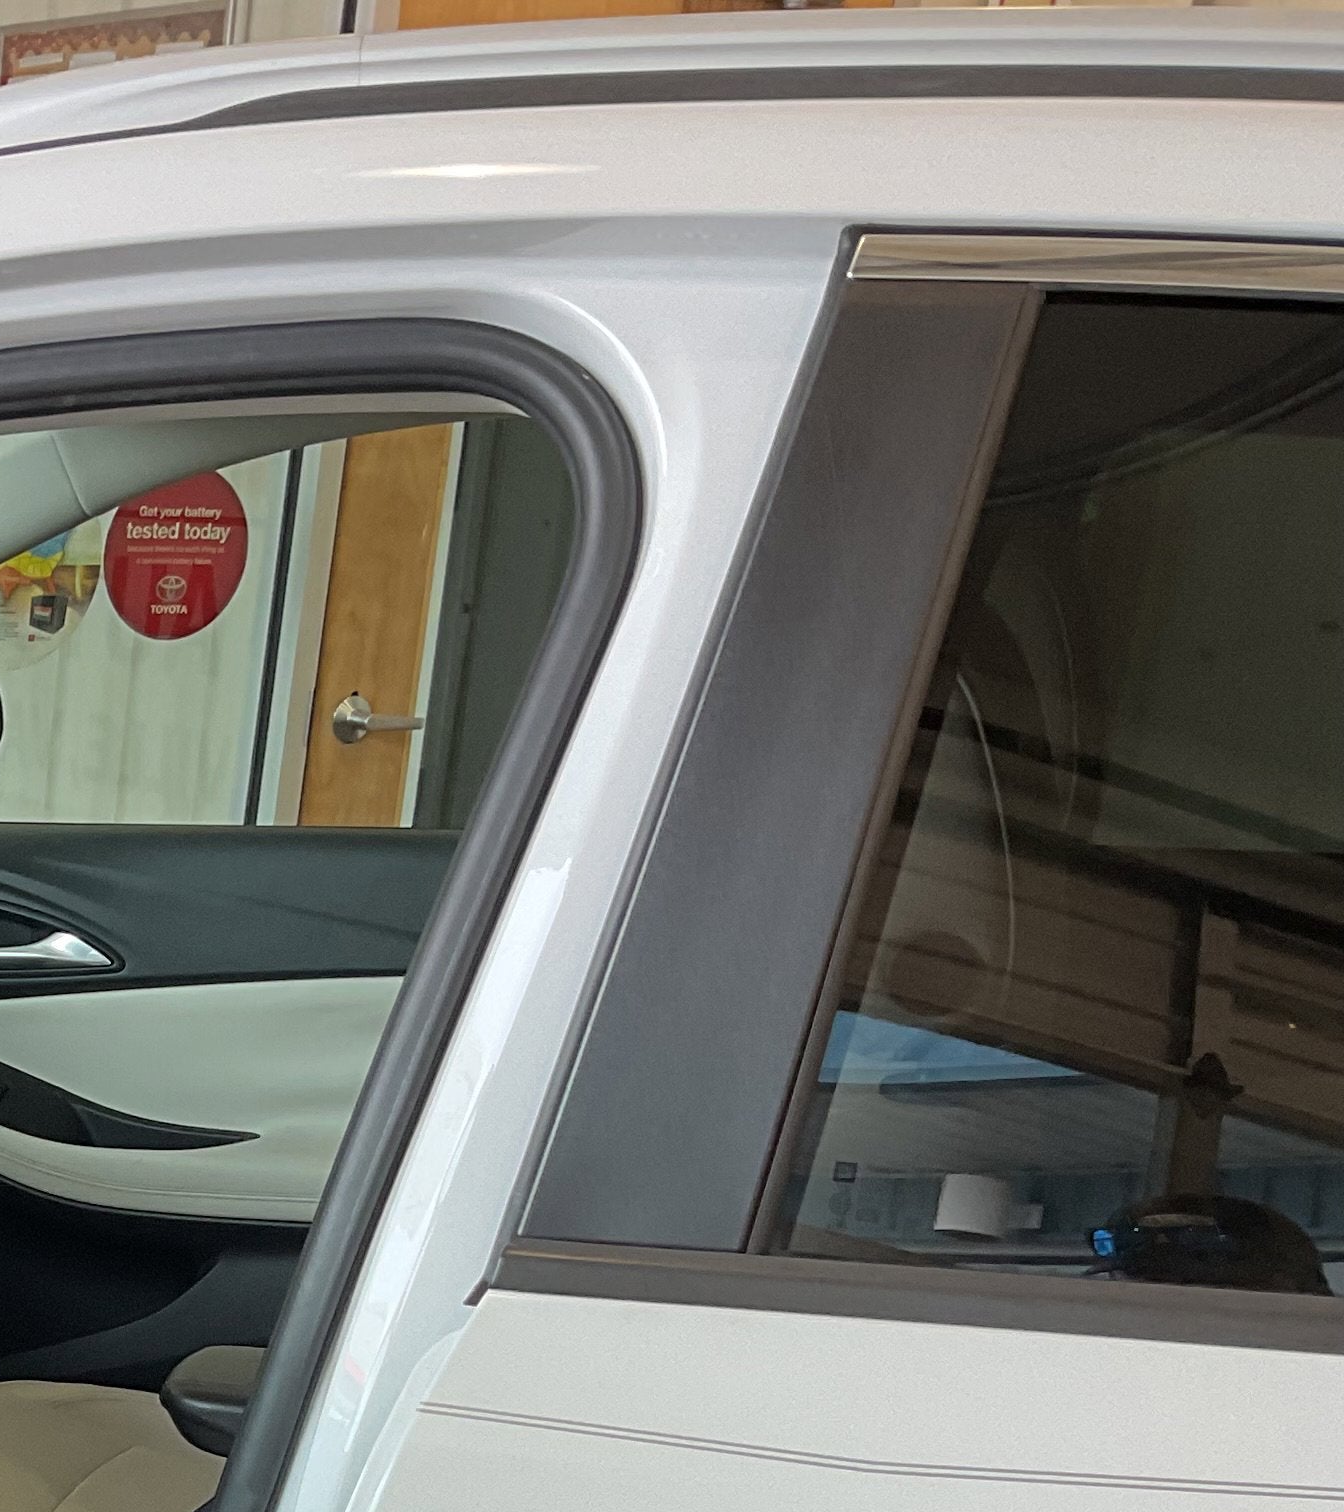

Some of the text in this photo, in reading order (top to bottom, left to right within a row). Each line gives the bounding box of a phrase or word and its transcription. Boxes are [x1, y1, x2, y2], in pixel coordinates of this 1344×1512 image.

[139, 505, 222, 520] Get your battery
[126, 522, 231, 544] tested today
[151, 604, 188, 615] TOYOTA
